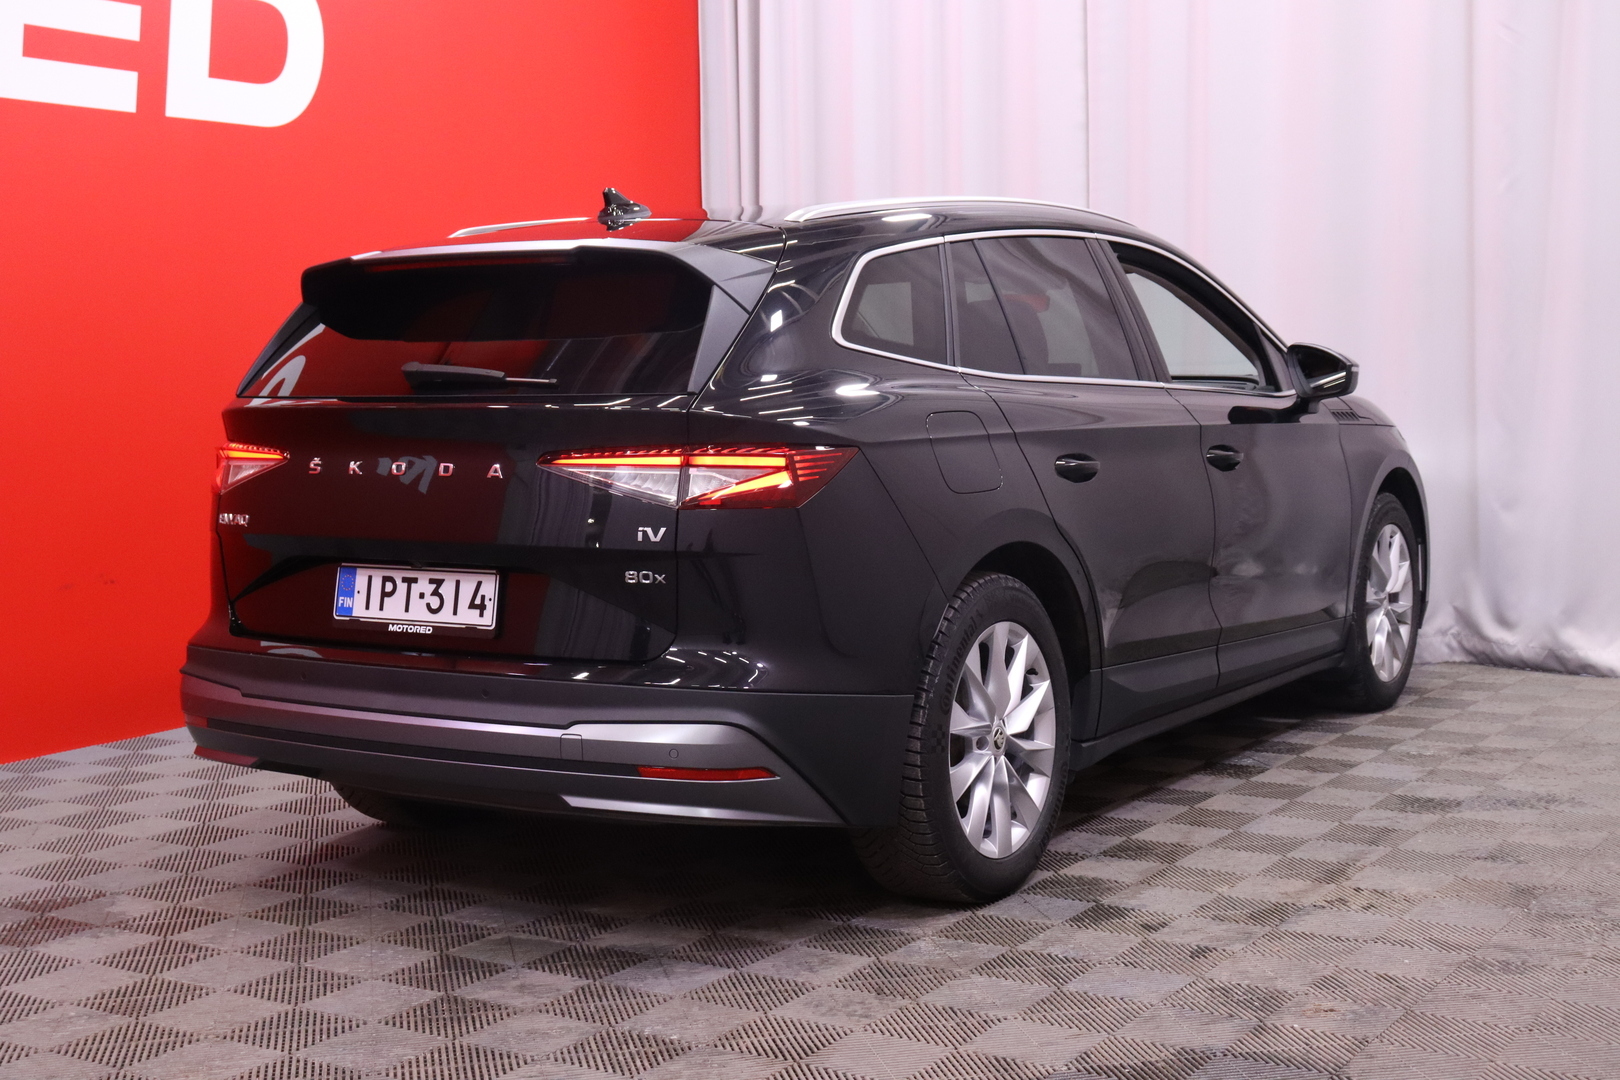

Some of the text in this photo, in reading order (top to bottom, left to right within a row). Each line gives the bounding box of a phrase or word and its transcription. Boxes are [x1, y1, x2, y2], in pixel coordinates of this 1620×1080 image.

[308, 457, 503, 479] ŠKODA
[637, 526, 667, 542] iV
[338, 597, 353, 608] FIN
[388, 624, 433, 634] MOTORED
